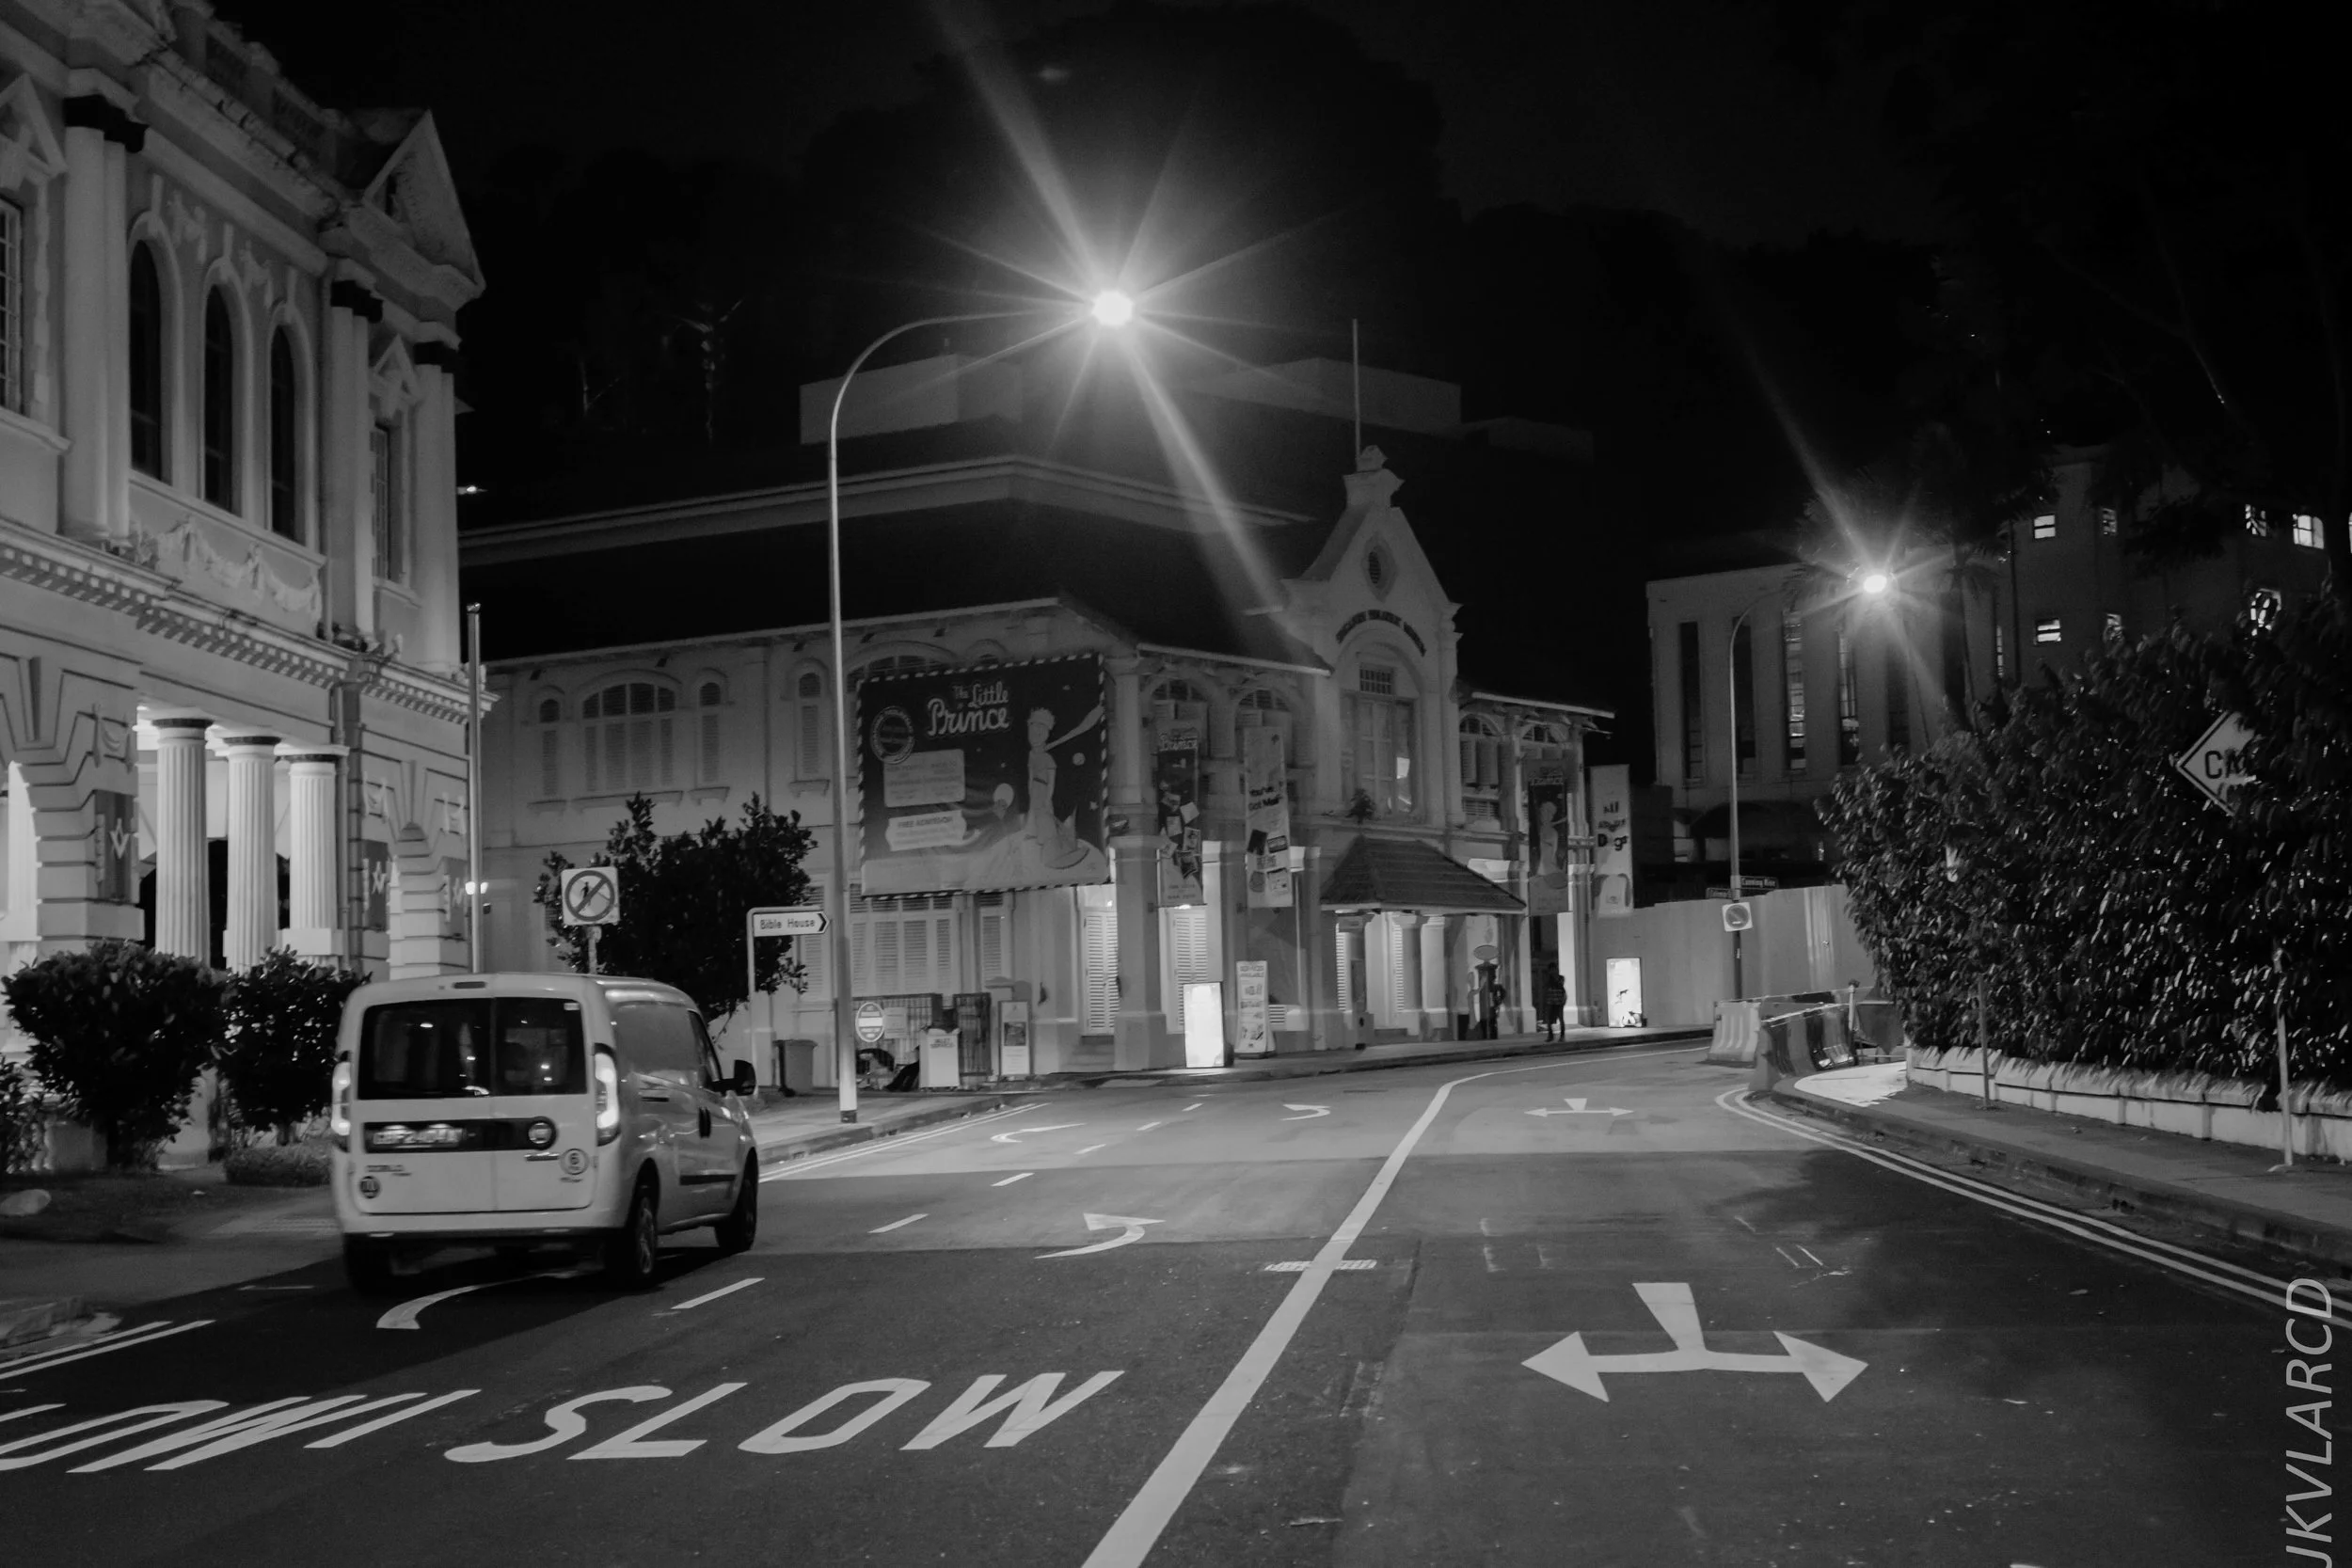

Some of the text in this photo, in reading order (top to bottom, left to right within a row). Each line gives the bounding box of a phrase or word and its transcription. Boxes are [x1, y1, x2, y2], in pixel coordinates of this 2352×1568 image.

[952, 681, 1009, 708] The Little
[927, 698, 1009, 736] Prince
[760, 918, 816, 930] Bible House
[443, 1370, 1125, 1463] SLOW
